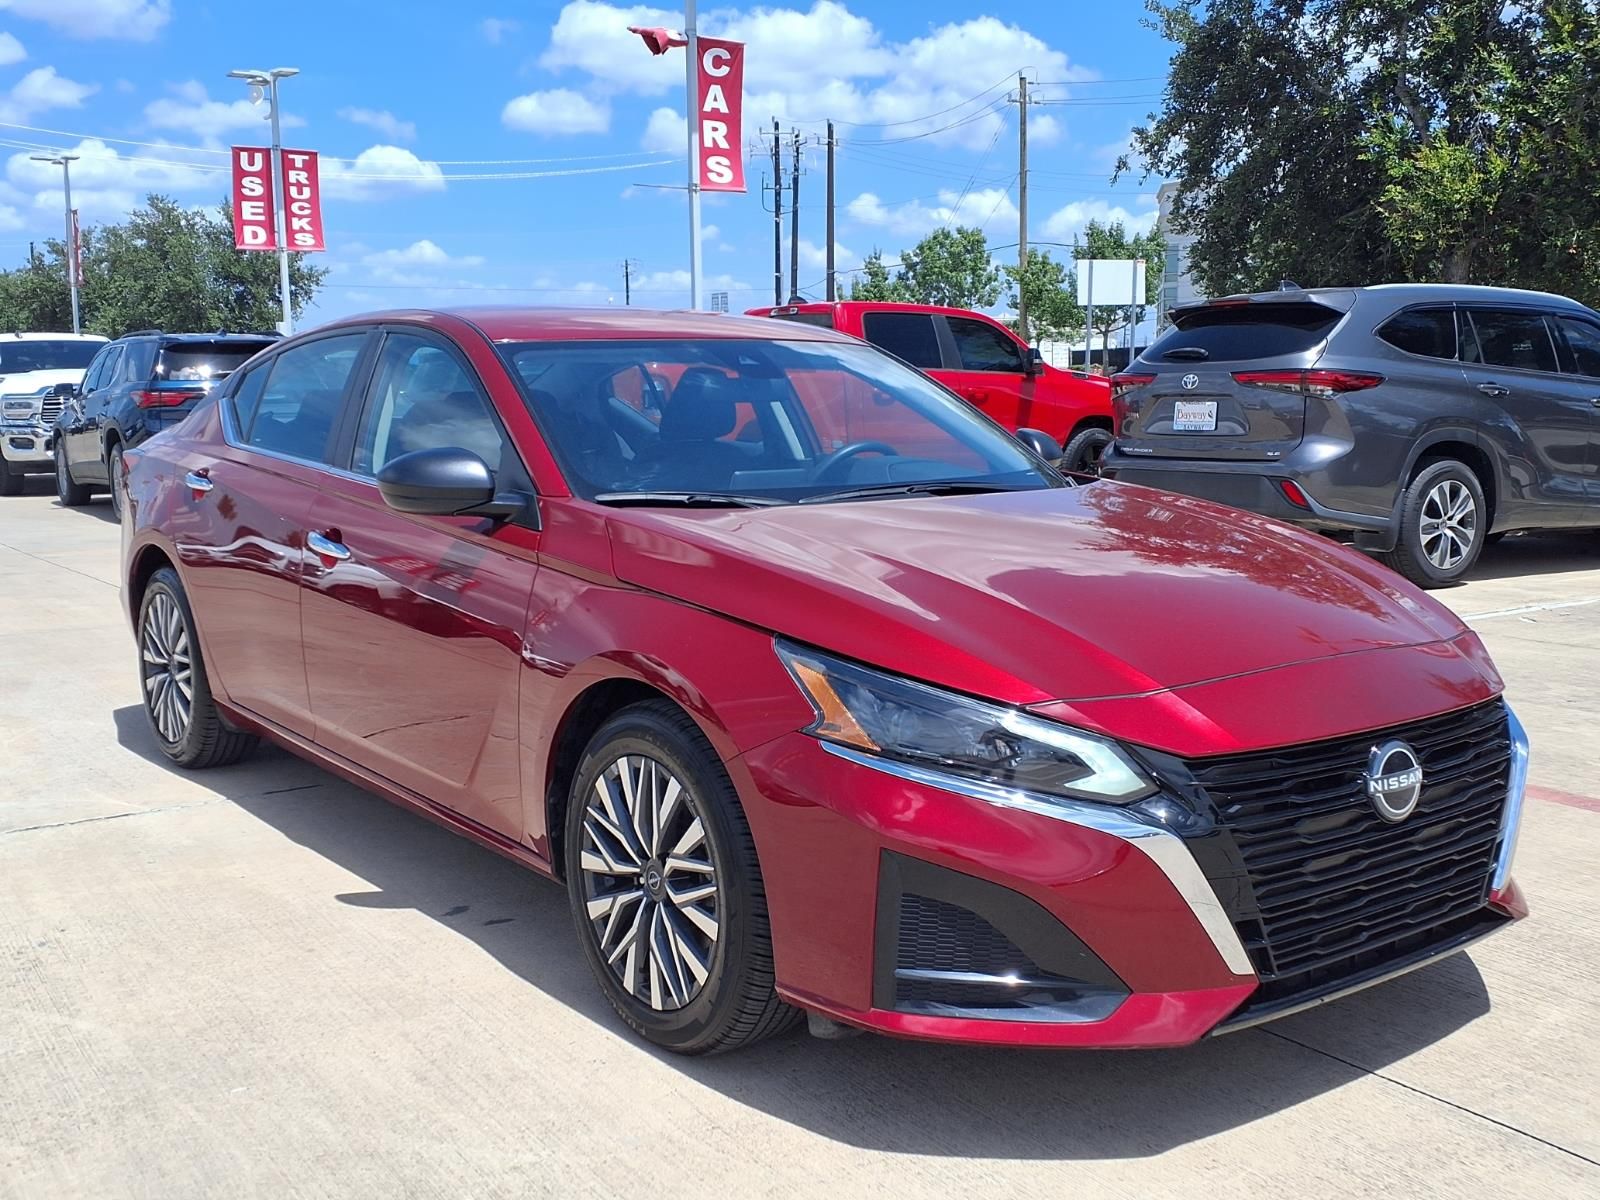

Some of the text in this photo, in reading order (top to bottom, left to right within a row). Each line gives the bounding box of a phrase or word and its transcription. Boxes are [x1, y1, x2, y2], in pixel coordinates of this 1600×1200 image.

[702, 47, 734, 184] CARS
[240, 151, 267, 245] USED
[288, 154, 316, 246] TRUCKS
[1369, 770, 1421, 792] NISSAN
